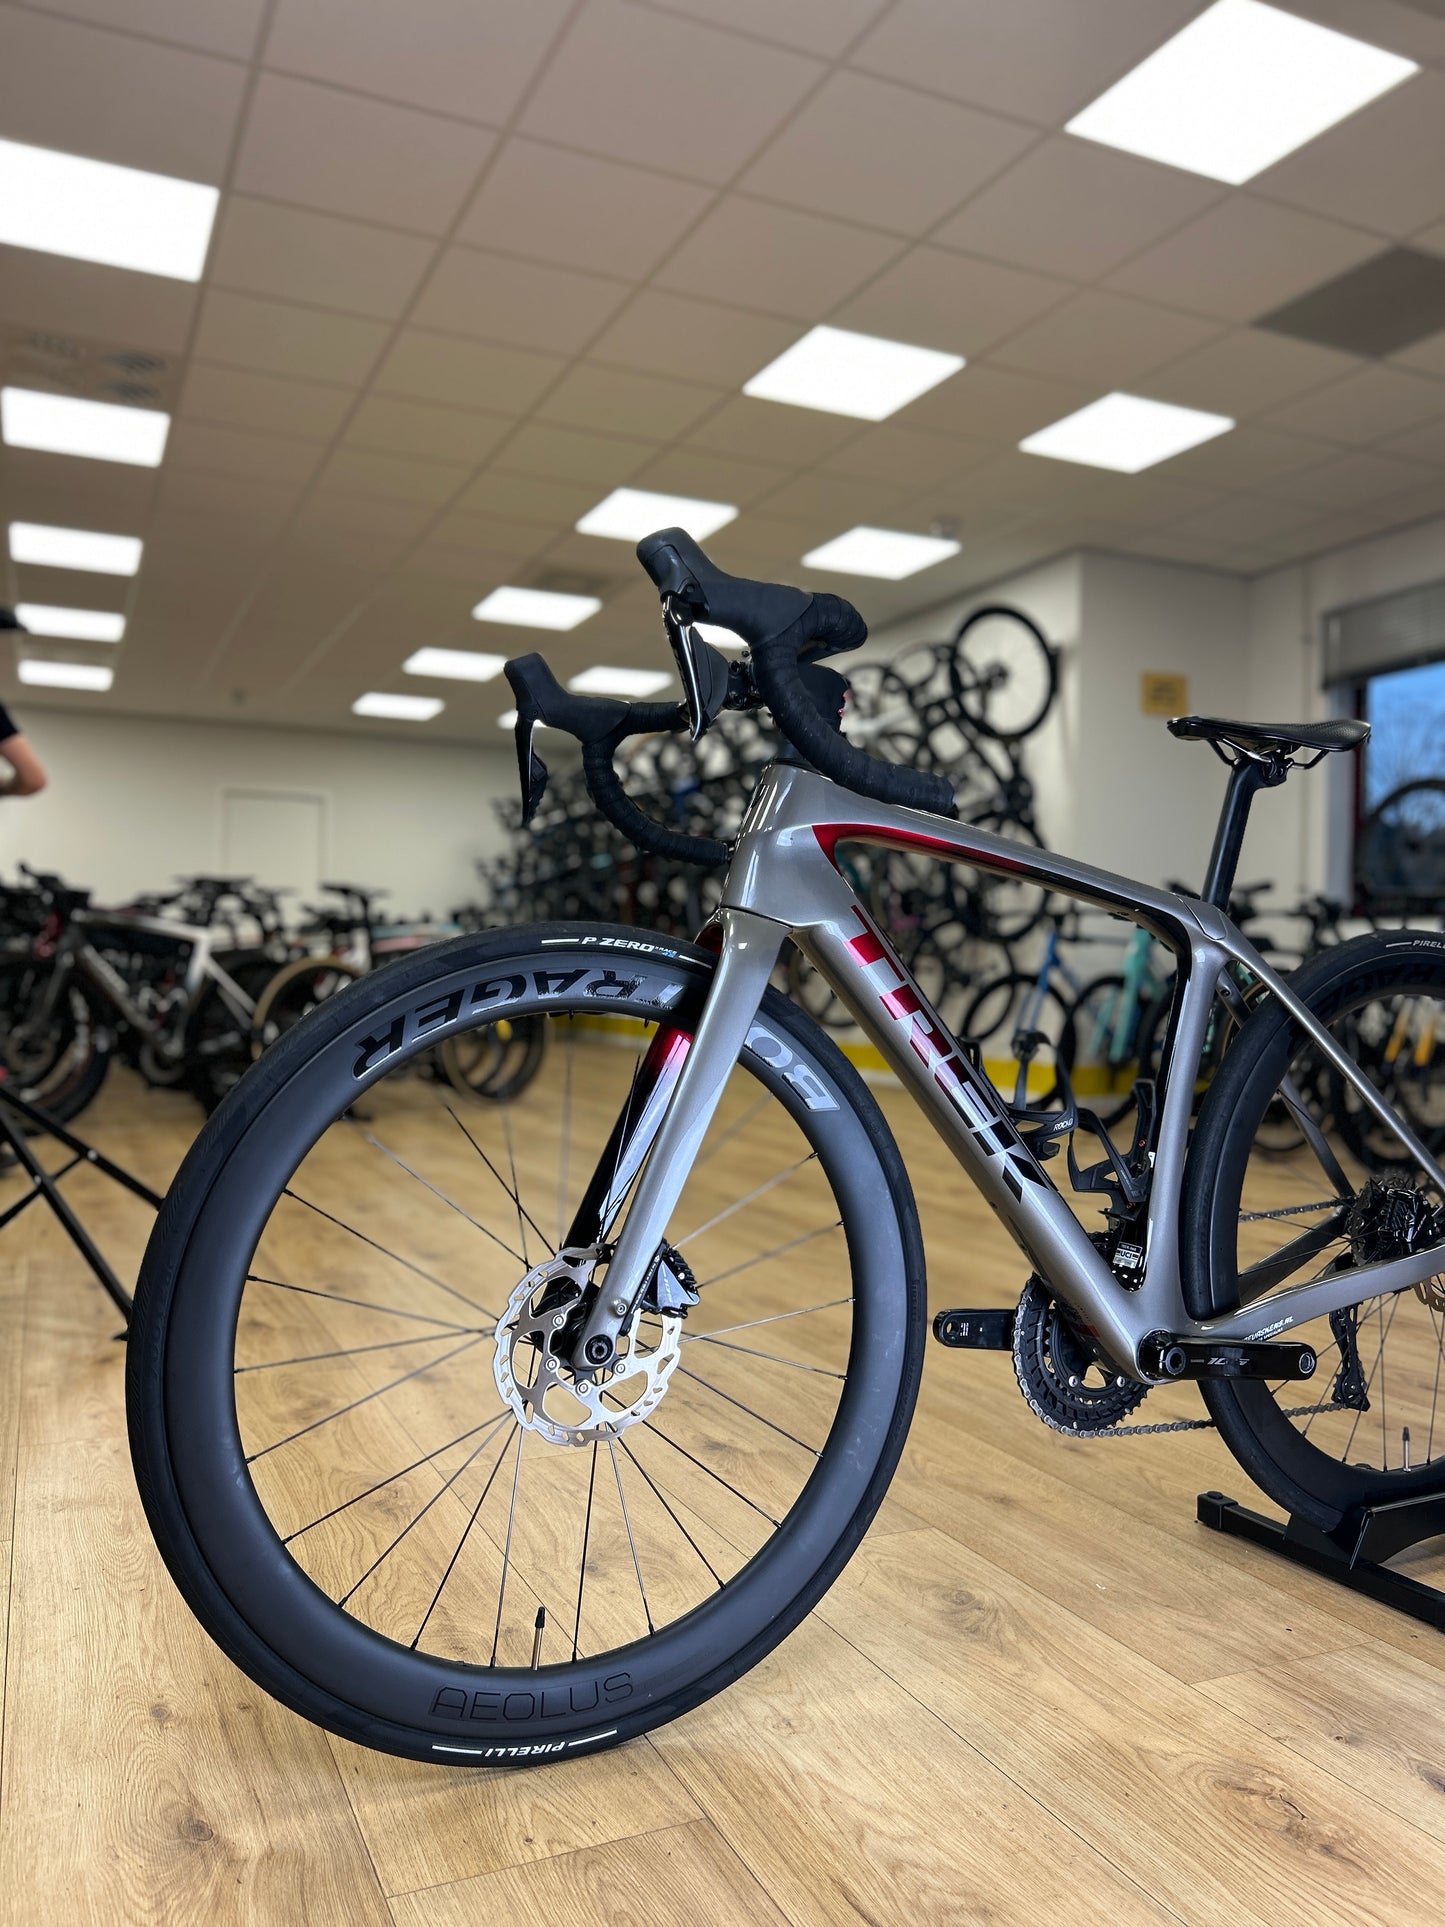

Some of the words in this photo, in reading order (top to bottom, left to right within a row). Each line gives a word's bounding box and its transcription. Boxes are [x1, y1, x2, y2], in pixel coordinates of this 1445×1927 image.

[581, 936, 597, 944] P
[599, 937, 655, 952] ZERO
[843, 904, 1051, 1204] TREK
[431, 1671, 634, 1721] AEOLUS
[484, 1741, 569, 1757] PIRELLI
